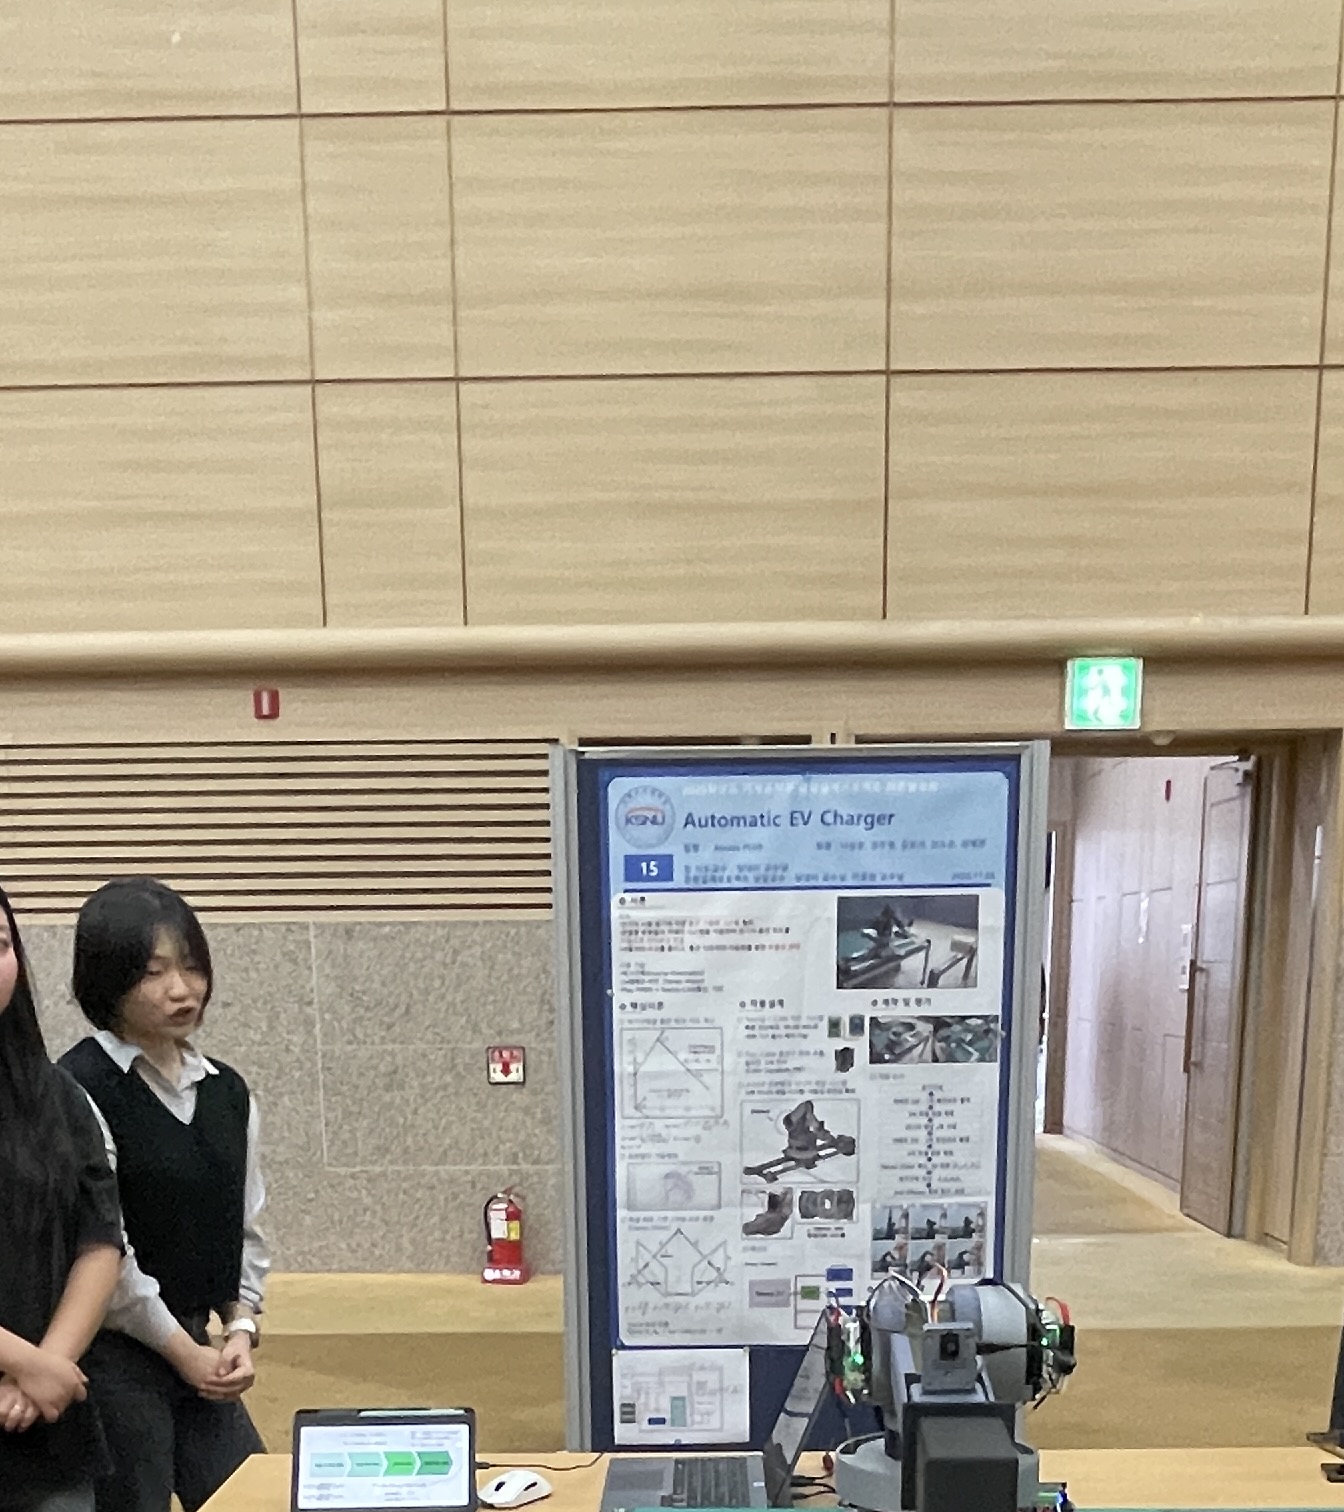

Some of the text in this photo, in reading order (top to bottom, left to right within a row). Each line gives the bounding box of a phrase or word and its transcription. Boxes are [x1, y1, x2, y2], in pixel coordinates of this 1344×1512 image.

[683, 809, 896, 831] Automatic EV Charger
[640, 861, 659, 877] 15
